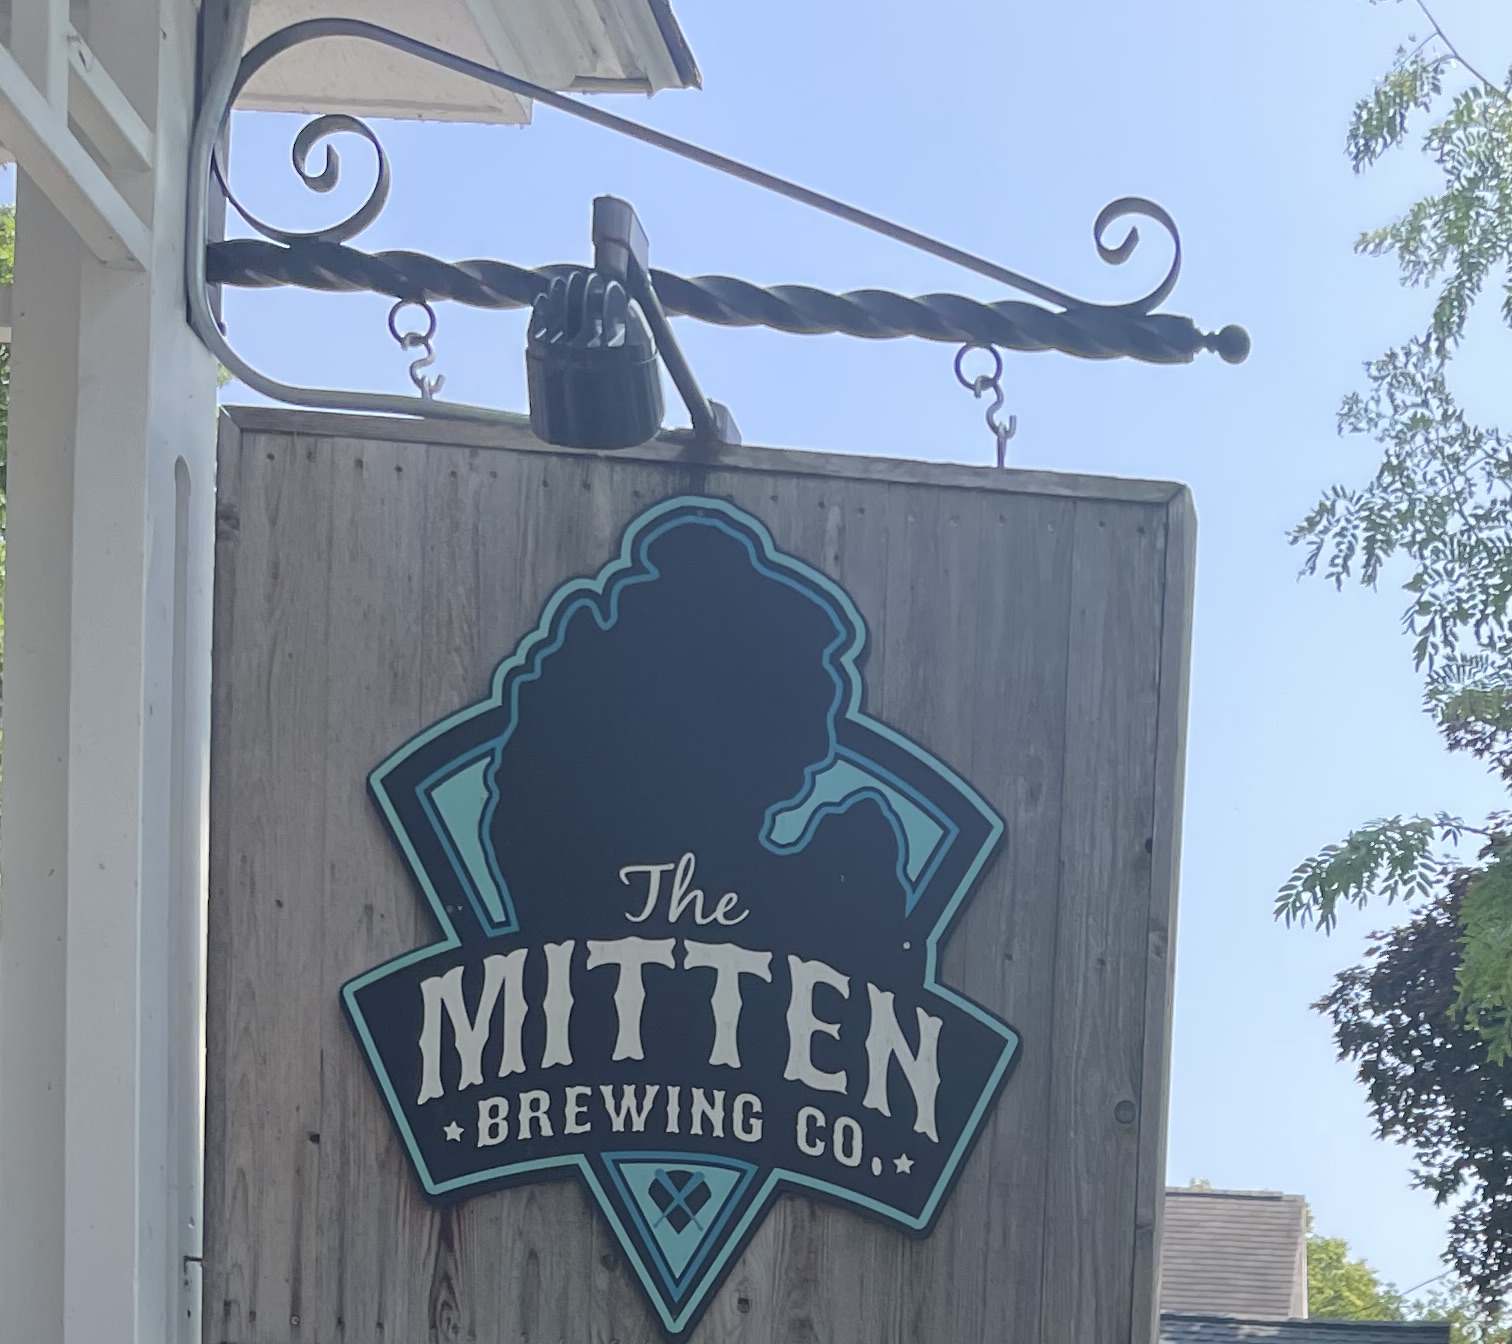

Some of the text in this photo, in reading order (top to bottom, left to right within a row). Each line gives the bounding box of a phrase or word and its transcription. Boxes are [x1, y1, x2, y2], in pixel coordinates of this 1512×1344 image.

[619, 852, 750, 926] The
[417, 936, 943, 1143] MITTEN
[477, 1084, 882, 1176] BREWING CO.
